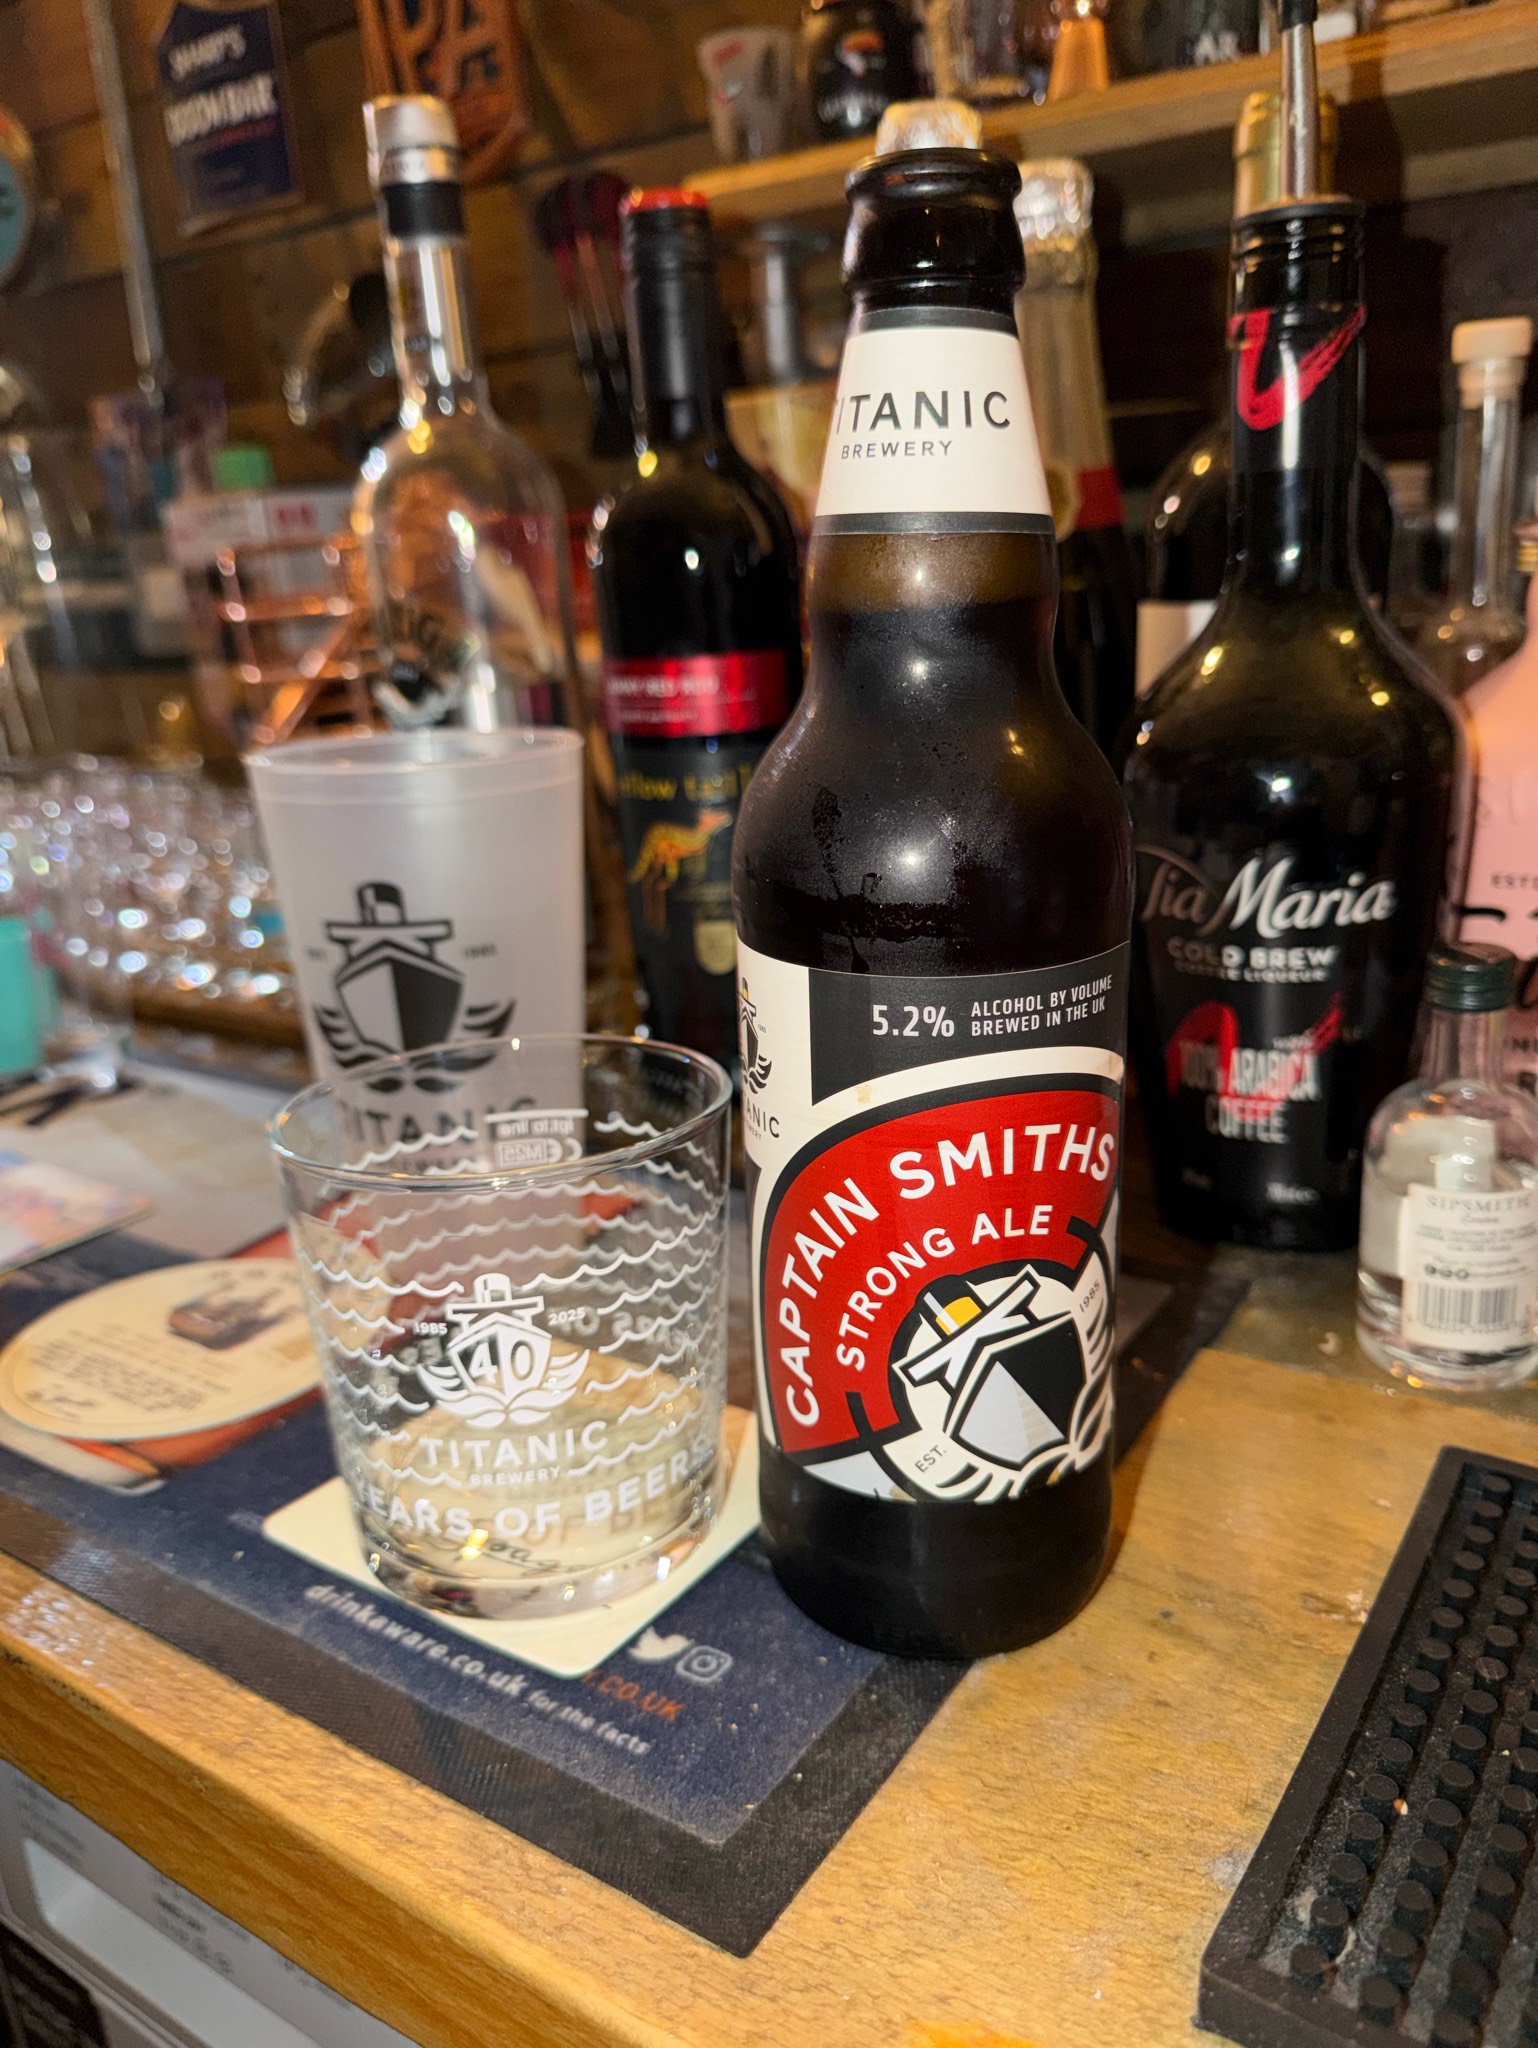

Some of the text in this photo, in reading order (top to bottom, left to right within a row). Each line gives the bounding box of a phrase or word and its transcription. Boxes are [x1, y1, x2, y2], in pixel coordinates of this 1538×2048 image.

[836, 391, 1012, 434] ITANIC
[841, 441, 953, 460] BREWERY
[1198, 855, 1397, 939] Maria
[1167, 938, 1338, 971] COLD BREW
[971, 974, 1113, 1017] ALCOHOL BY VOLUME
[873, 1004, 955, 1037] 5.2%
[971, 996, 1106, 1036] BREWED IN THE UK
[779, 1123, 1115, 1426] CAPTAIN SMITHS
[836, 1204, 1053, 1372] STRONG ALE
[1079, 1279, 1101, 1314] 1985
[412, 1307, 587, 1336] 1985 2025
[467, 1339, 535, 1386] 40
[417, 1420, 609, 1469] TITANIC
[914, 1444, 947, 1474] EST.
[470, 1465, 561, 1487] BREWERY
[493, 1500, 561, 1538] OF
[306, 1582, 653, 1756] drinkaware.co.uk for the facts
